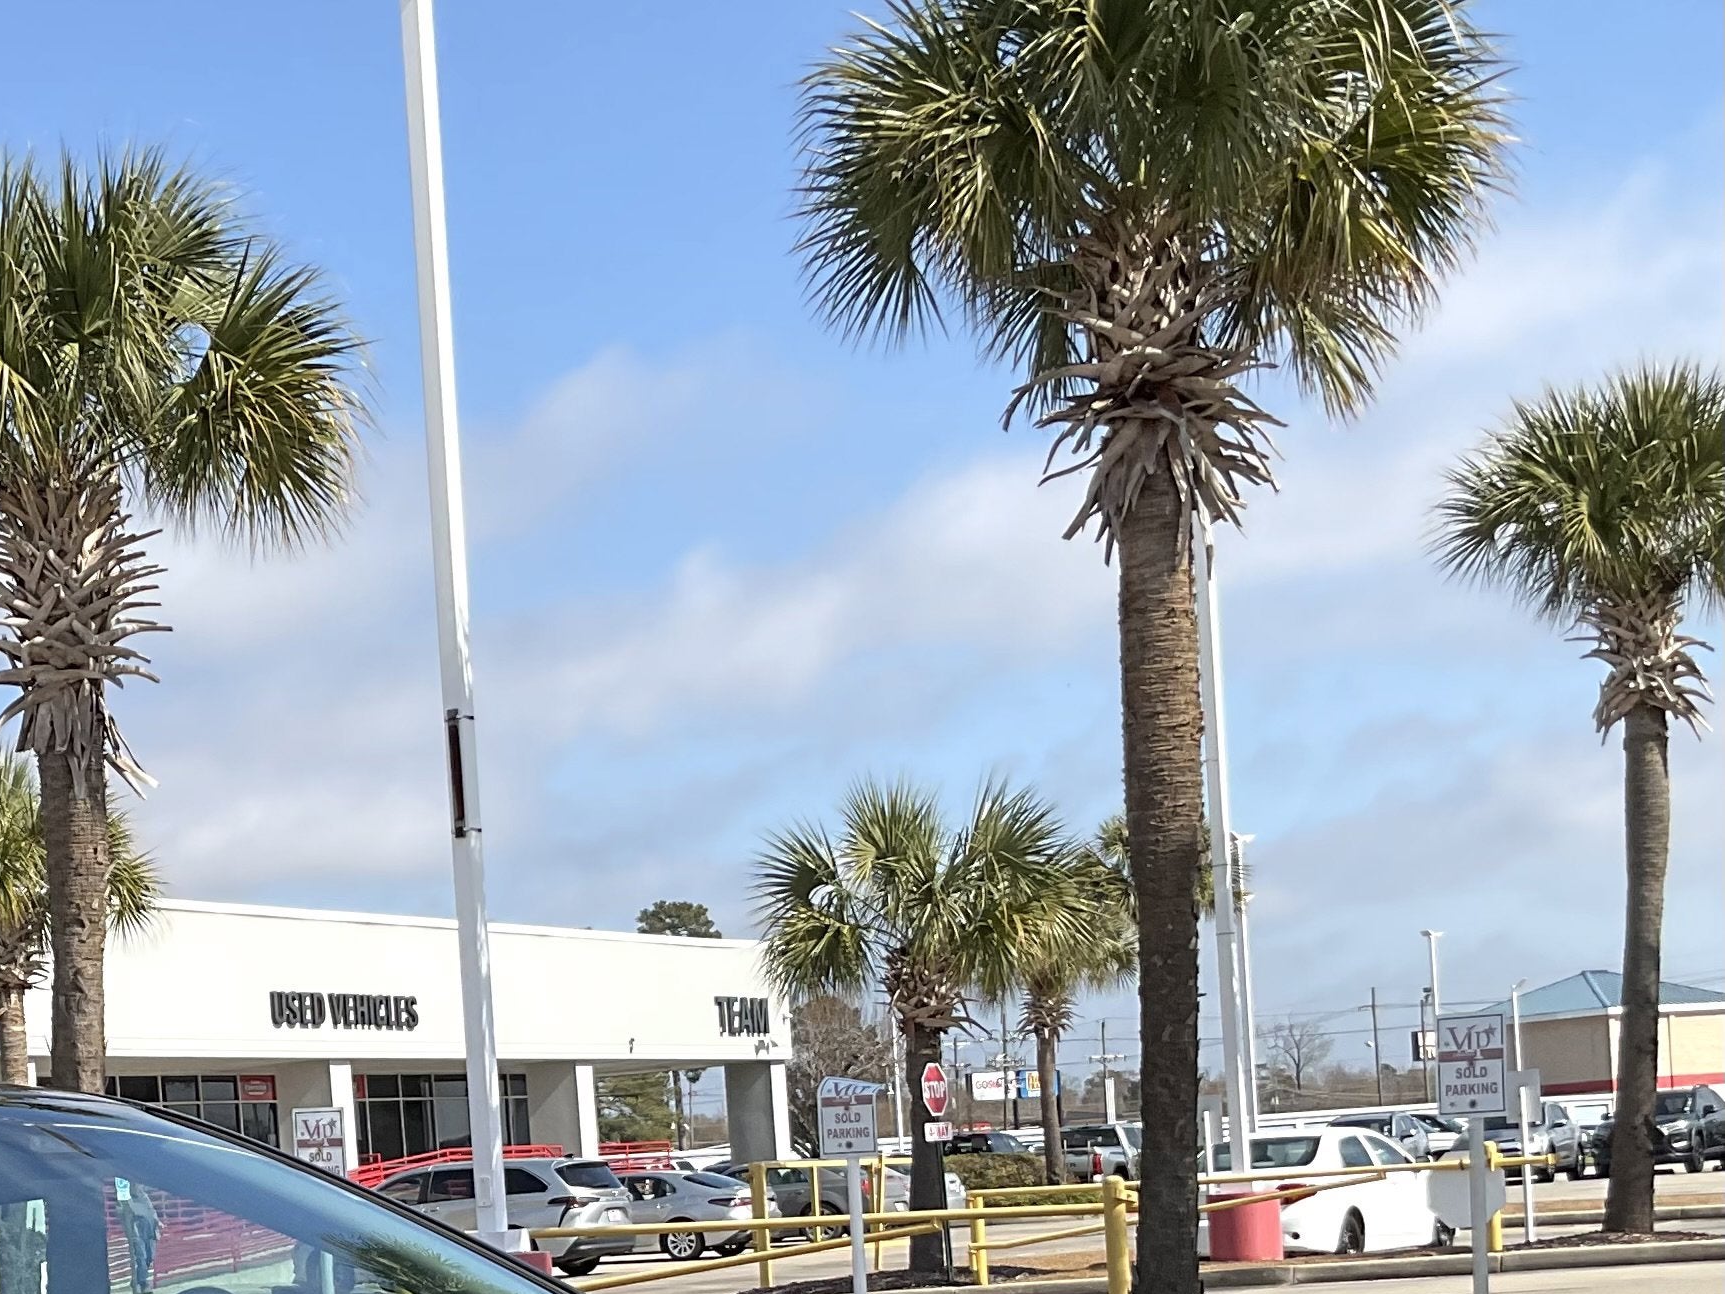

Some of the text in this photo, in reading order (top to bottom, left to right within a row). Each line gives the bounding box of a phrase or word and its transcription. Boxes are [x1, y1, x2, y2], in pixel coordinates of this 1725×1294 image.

[269, 991, 418, 1031] USED VEHICLES
[714, 996, 769, 1036] TEAM
[1455, 1066, 1487, 1079] SOLD
[924, 1080, 945, 1099] STOP
[1445, 1082, 1498, 1096] PARKING
[834, 1112, 861, 1123] SOLD
[826, 1127, 870, 1139] PARKING
[309, 1151, 332, 1162] SOLD
